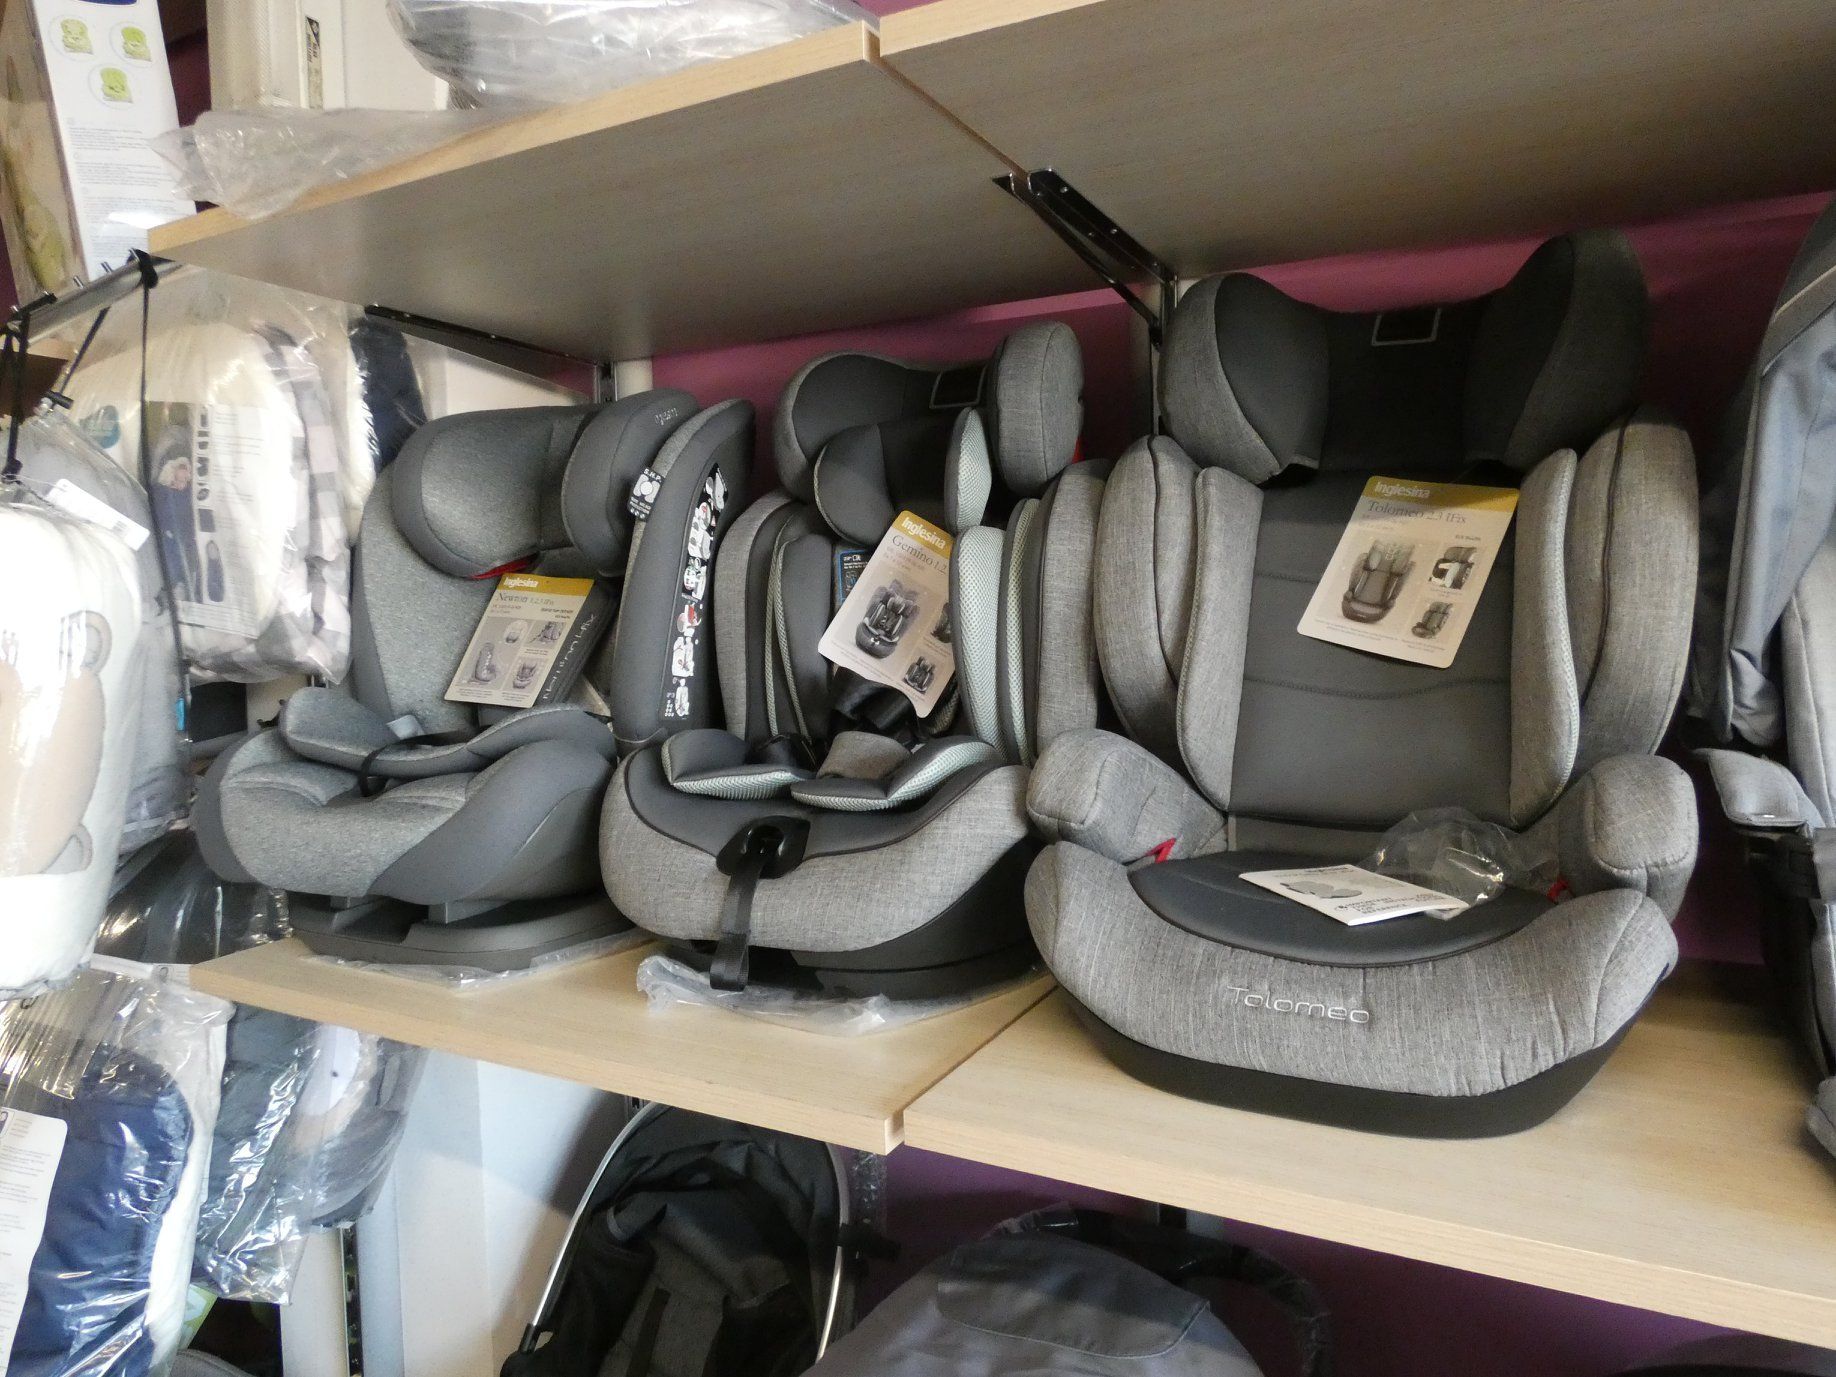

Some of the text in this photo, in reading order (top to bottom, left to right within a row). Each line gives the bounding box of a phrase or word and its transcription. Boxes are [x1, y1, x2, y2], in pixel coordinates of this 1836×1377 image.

[1374, 481, 1431, 499] Inglesina
[1368, 500, 1424, 518] Tolomeo
[901, 516, 946, 549] Inglesina
[892, 534, 933, 566] Gemino
[503, 577, 539, 588] Inglesina
[1226, 985, 1370, 1024] Tolomeo
